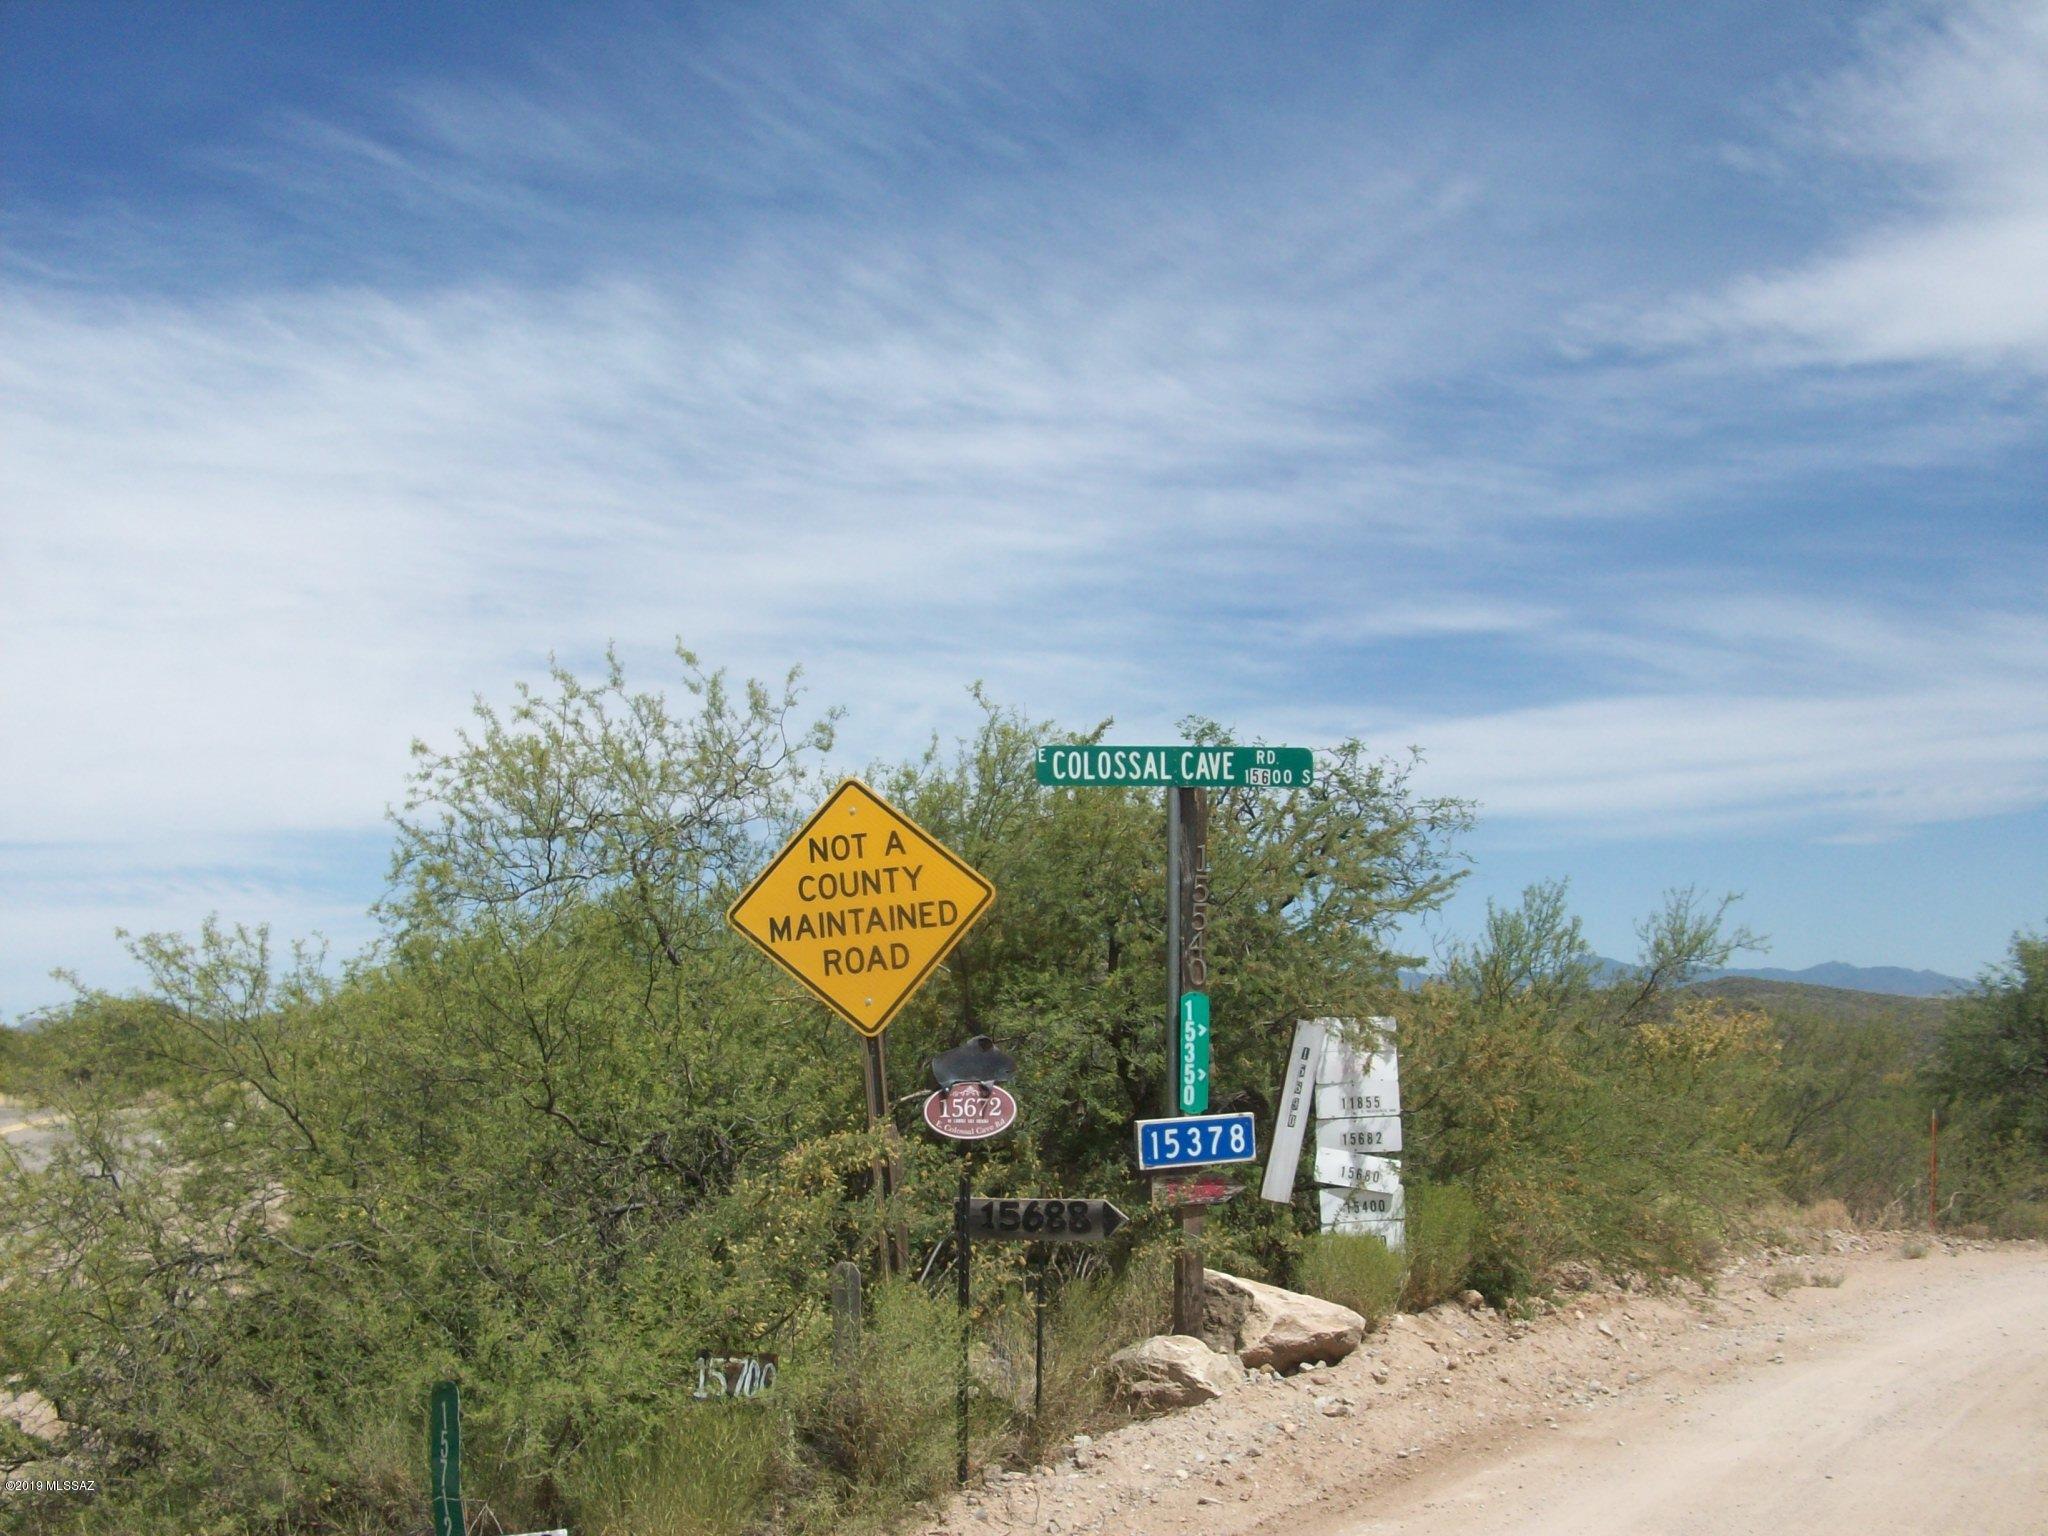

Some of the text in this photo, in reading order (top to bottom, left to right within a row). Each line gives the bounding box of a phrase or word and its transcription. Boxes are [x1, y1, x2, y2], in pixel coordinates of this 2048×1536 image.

[1038, 749, 1047, 763] E
[1052, 750, 1173, 781] COLOSSAL
[1180, 751, 1235, 780] CAVE
[1245, 769, 1311, 784] 15600 S
[809, 830, 906, 863] NOT A
[798, 864, 923, 902] COUNTY
[768, 899, 958, 944] MAINTAINED
[1189, 844, 1210, 986] 15540
[823, 942, 910, 977] ROAD
[1183, 1000, 1196, 1106] 15350
[939, 1096, 1002, 1118] 15672
[1341, 1096, 1381, 1110] 11855
[1150, 1123, 1245, 1160] 15378
[1342, 1131, 1382, 1146] 15682
[1340, 1166, 1380, 1183] 15680
[980, 1200, 1092, 1234] 15688
[693, 1356, 777, 1398] 15700
